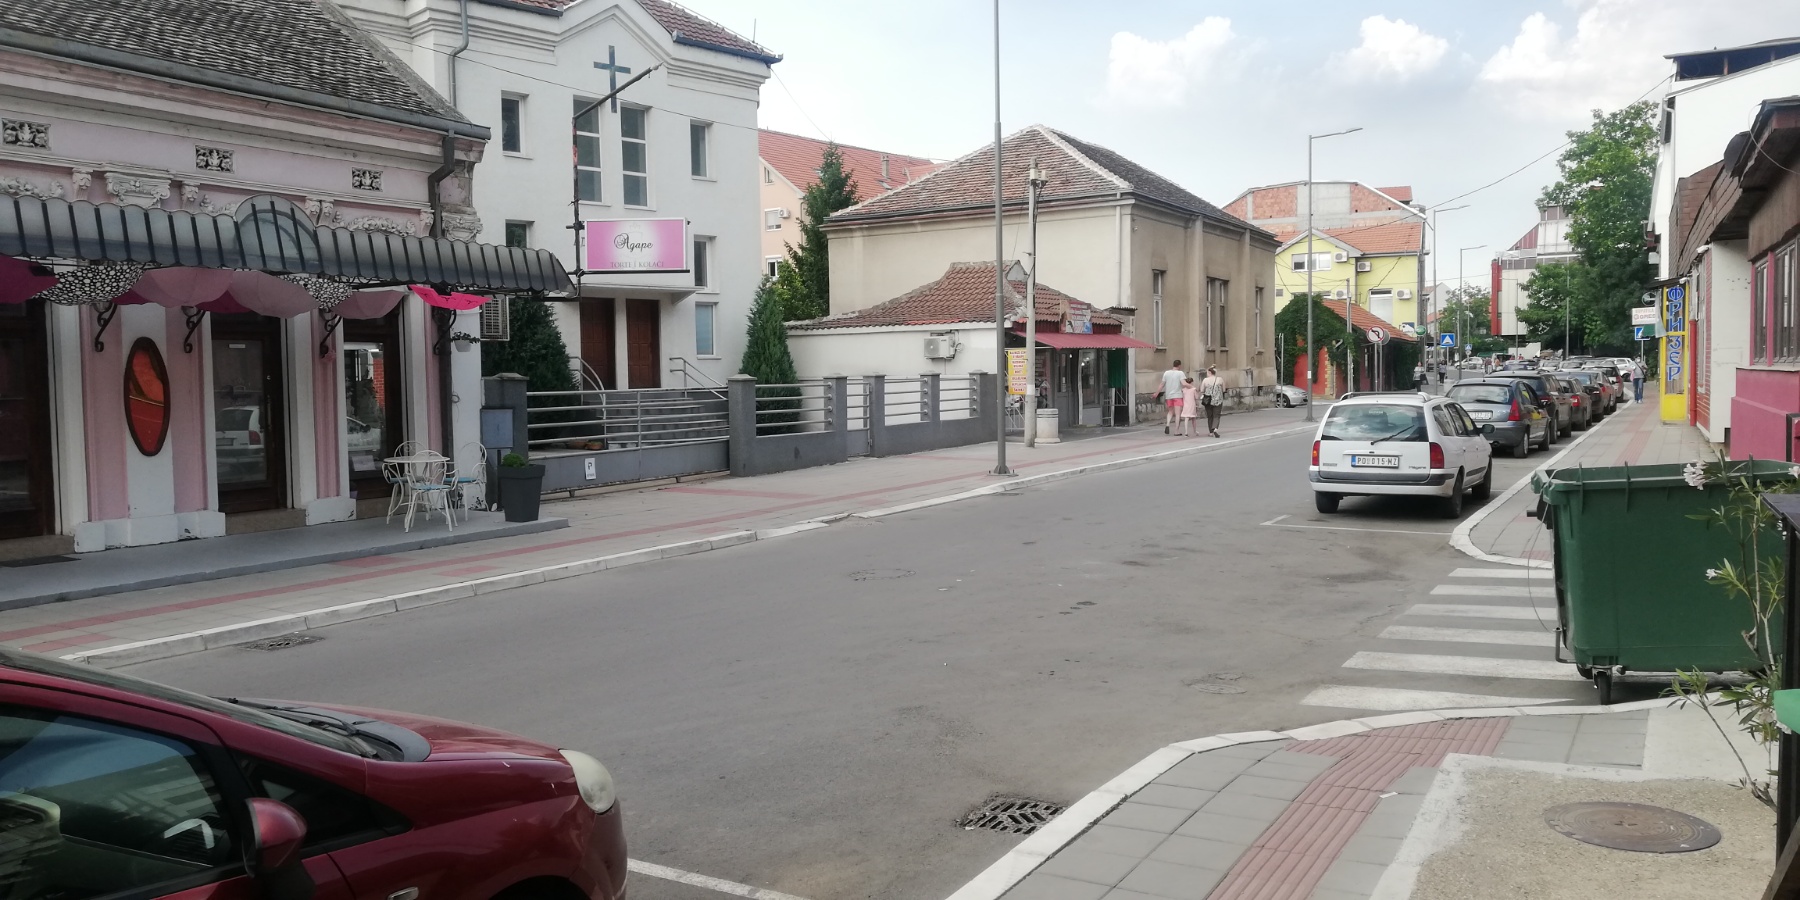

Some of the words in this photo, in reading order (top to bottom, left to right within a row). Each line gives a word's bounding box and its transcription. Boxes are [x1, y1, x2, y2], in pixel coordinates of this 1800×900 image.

[613, 233, 653, 252] Agape
[1668, 286, 1684, 381] ФРИЗЕР
[1357, 457, 1366, 465] PO
